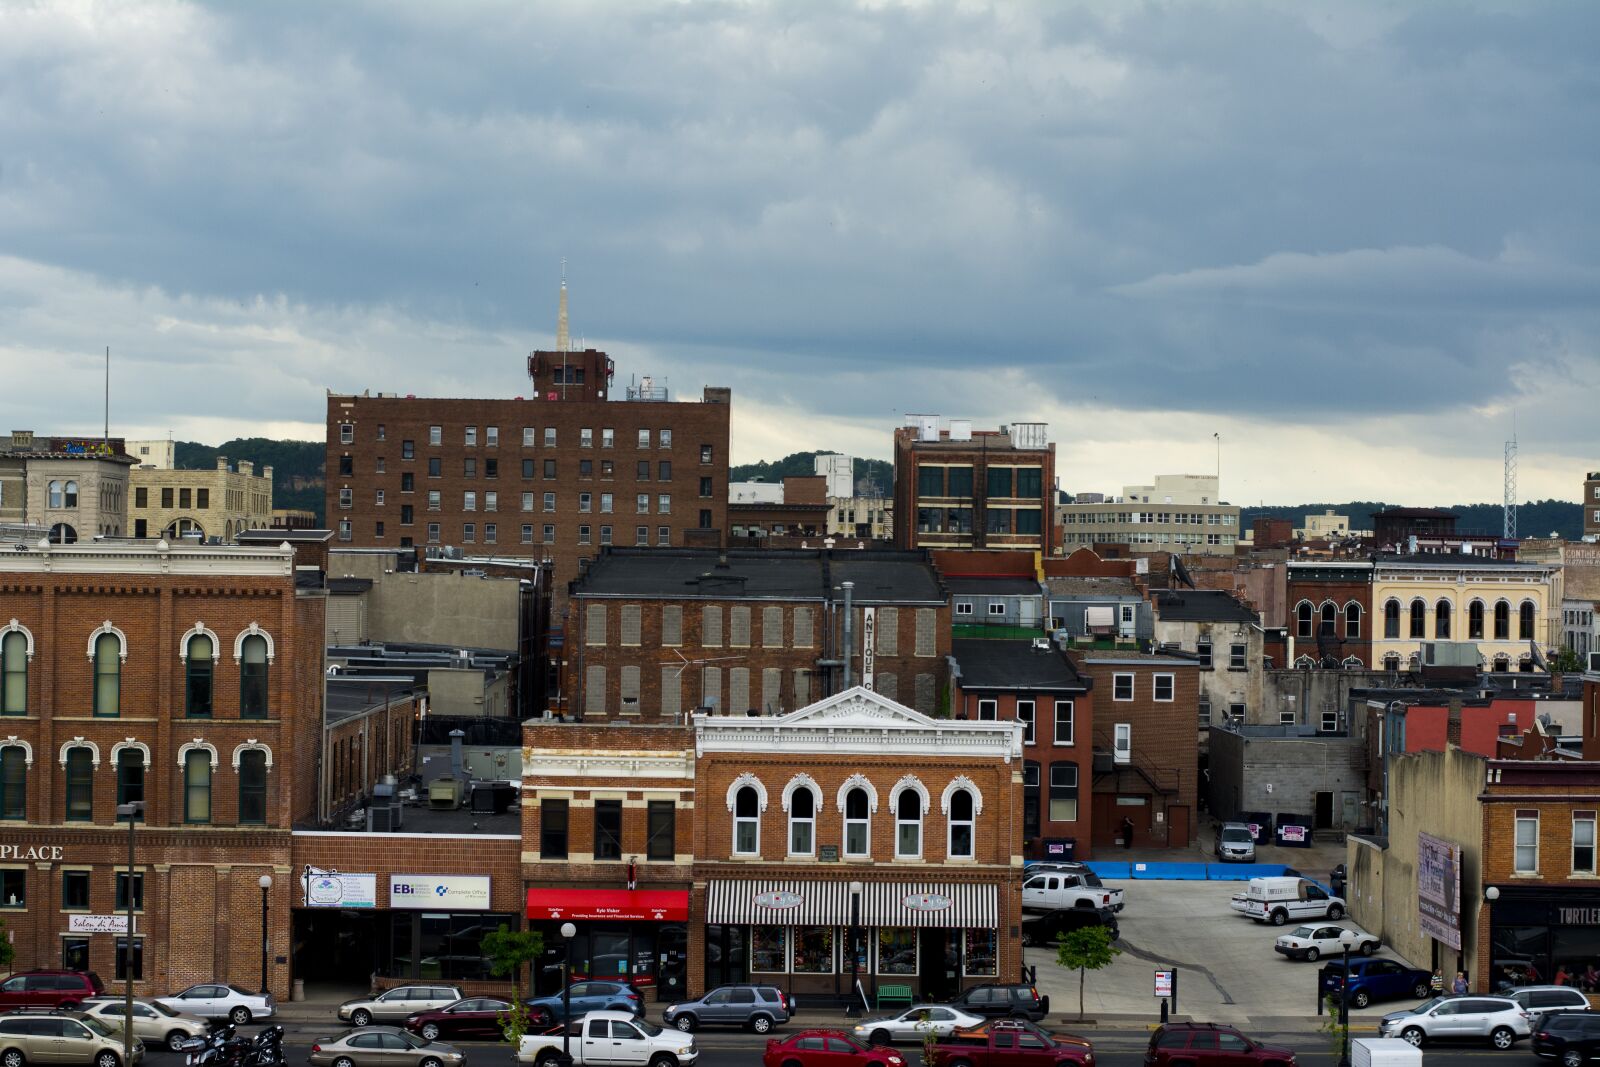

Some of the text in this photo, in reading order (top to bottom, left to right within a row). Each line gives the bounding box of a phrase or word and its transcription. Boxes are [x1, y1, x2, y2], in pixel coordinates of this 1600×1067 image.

[0, 845, 63, 860] PLACE
[73, 918, 129, 928] Salon di Amic
